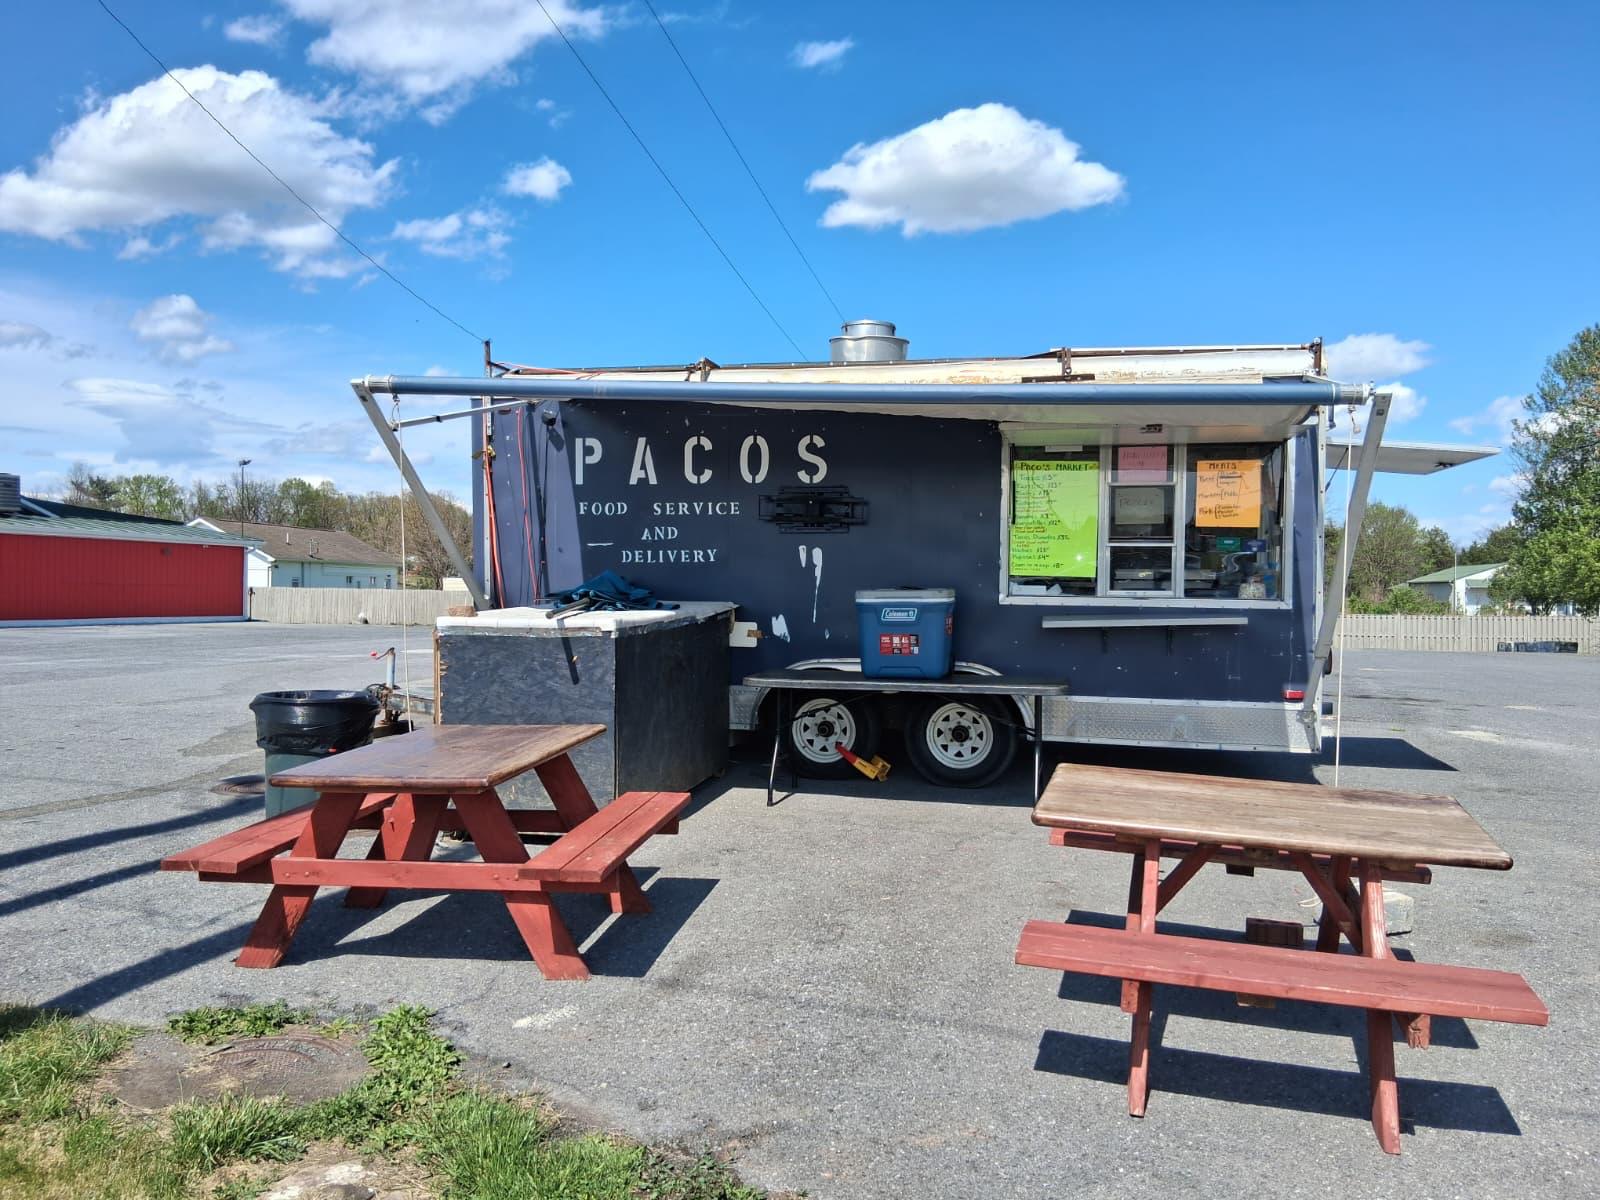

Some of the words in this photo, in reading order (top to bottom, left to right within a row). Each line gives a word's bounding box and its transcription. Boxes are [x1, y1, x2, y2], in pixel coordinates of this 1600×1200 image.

[575, 434, 828, 485] PACOS
[1056, 463, 1089, 471] MARKET
[579, 502, 628, 516] FOOD
[653, 502, 740, 515] SERVICE
[641, 526, 678, 541] AND
[621, 548, 718, 564] DELIVERY
[885, 609, 908, 617] Coleman
